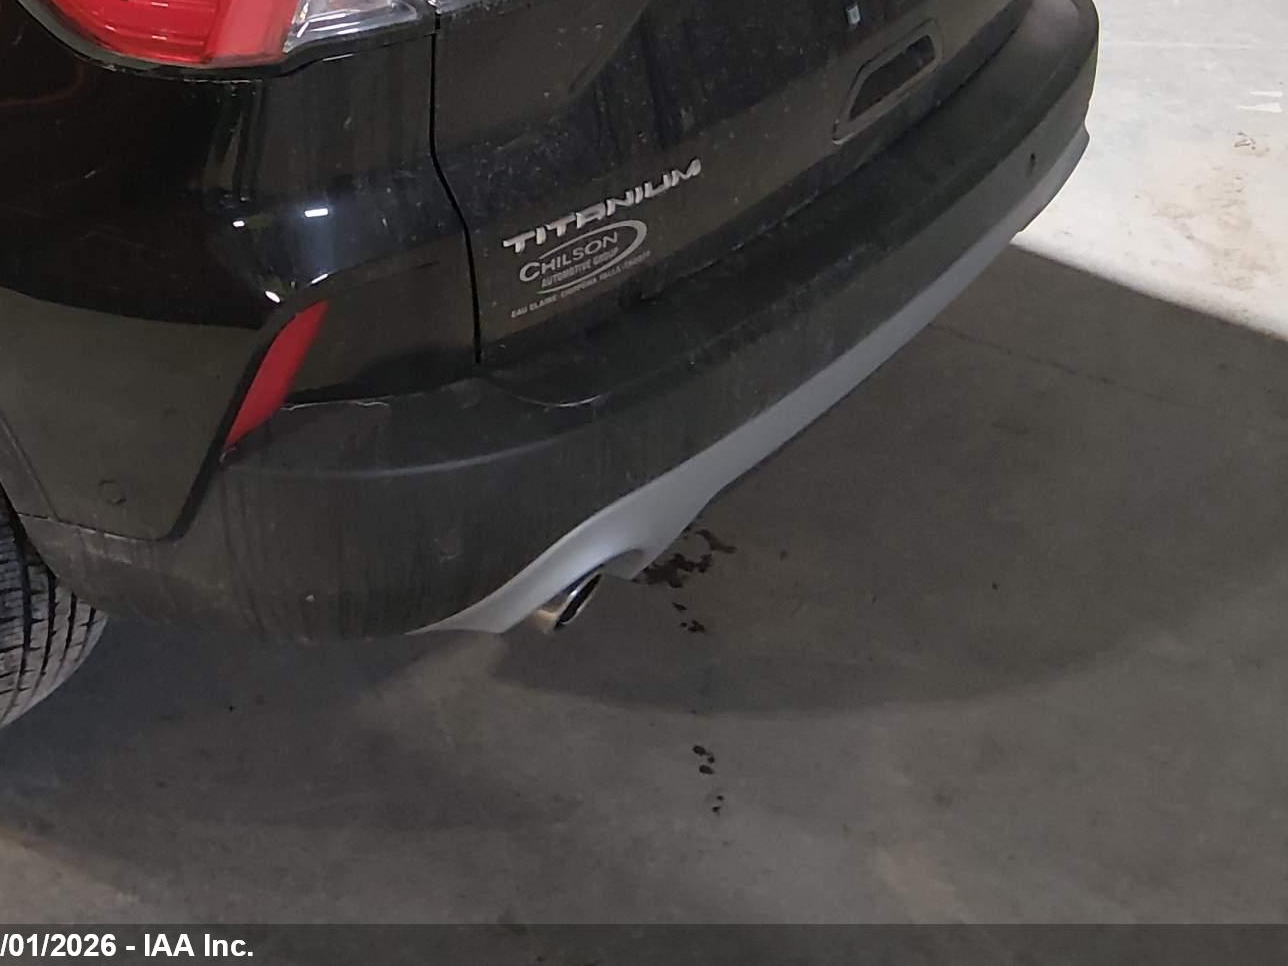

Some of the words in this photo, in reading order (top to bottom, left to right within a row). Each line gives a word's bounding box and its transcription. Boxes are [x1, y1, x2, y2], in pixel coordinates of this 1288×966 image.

[502, 158, 702, 253] TITANIUM
[519, 232, 618, 282] CHILSON
[541, 259, 592, 288] AUTOMOTIVE
